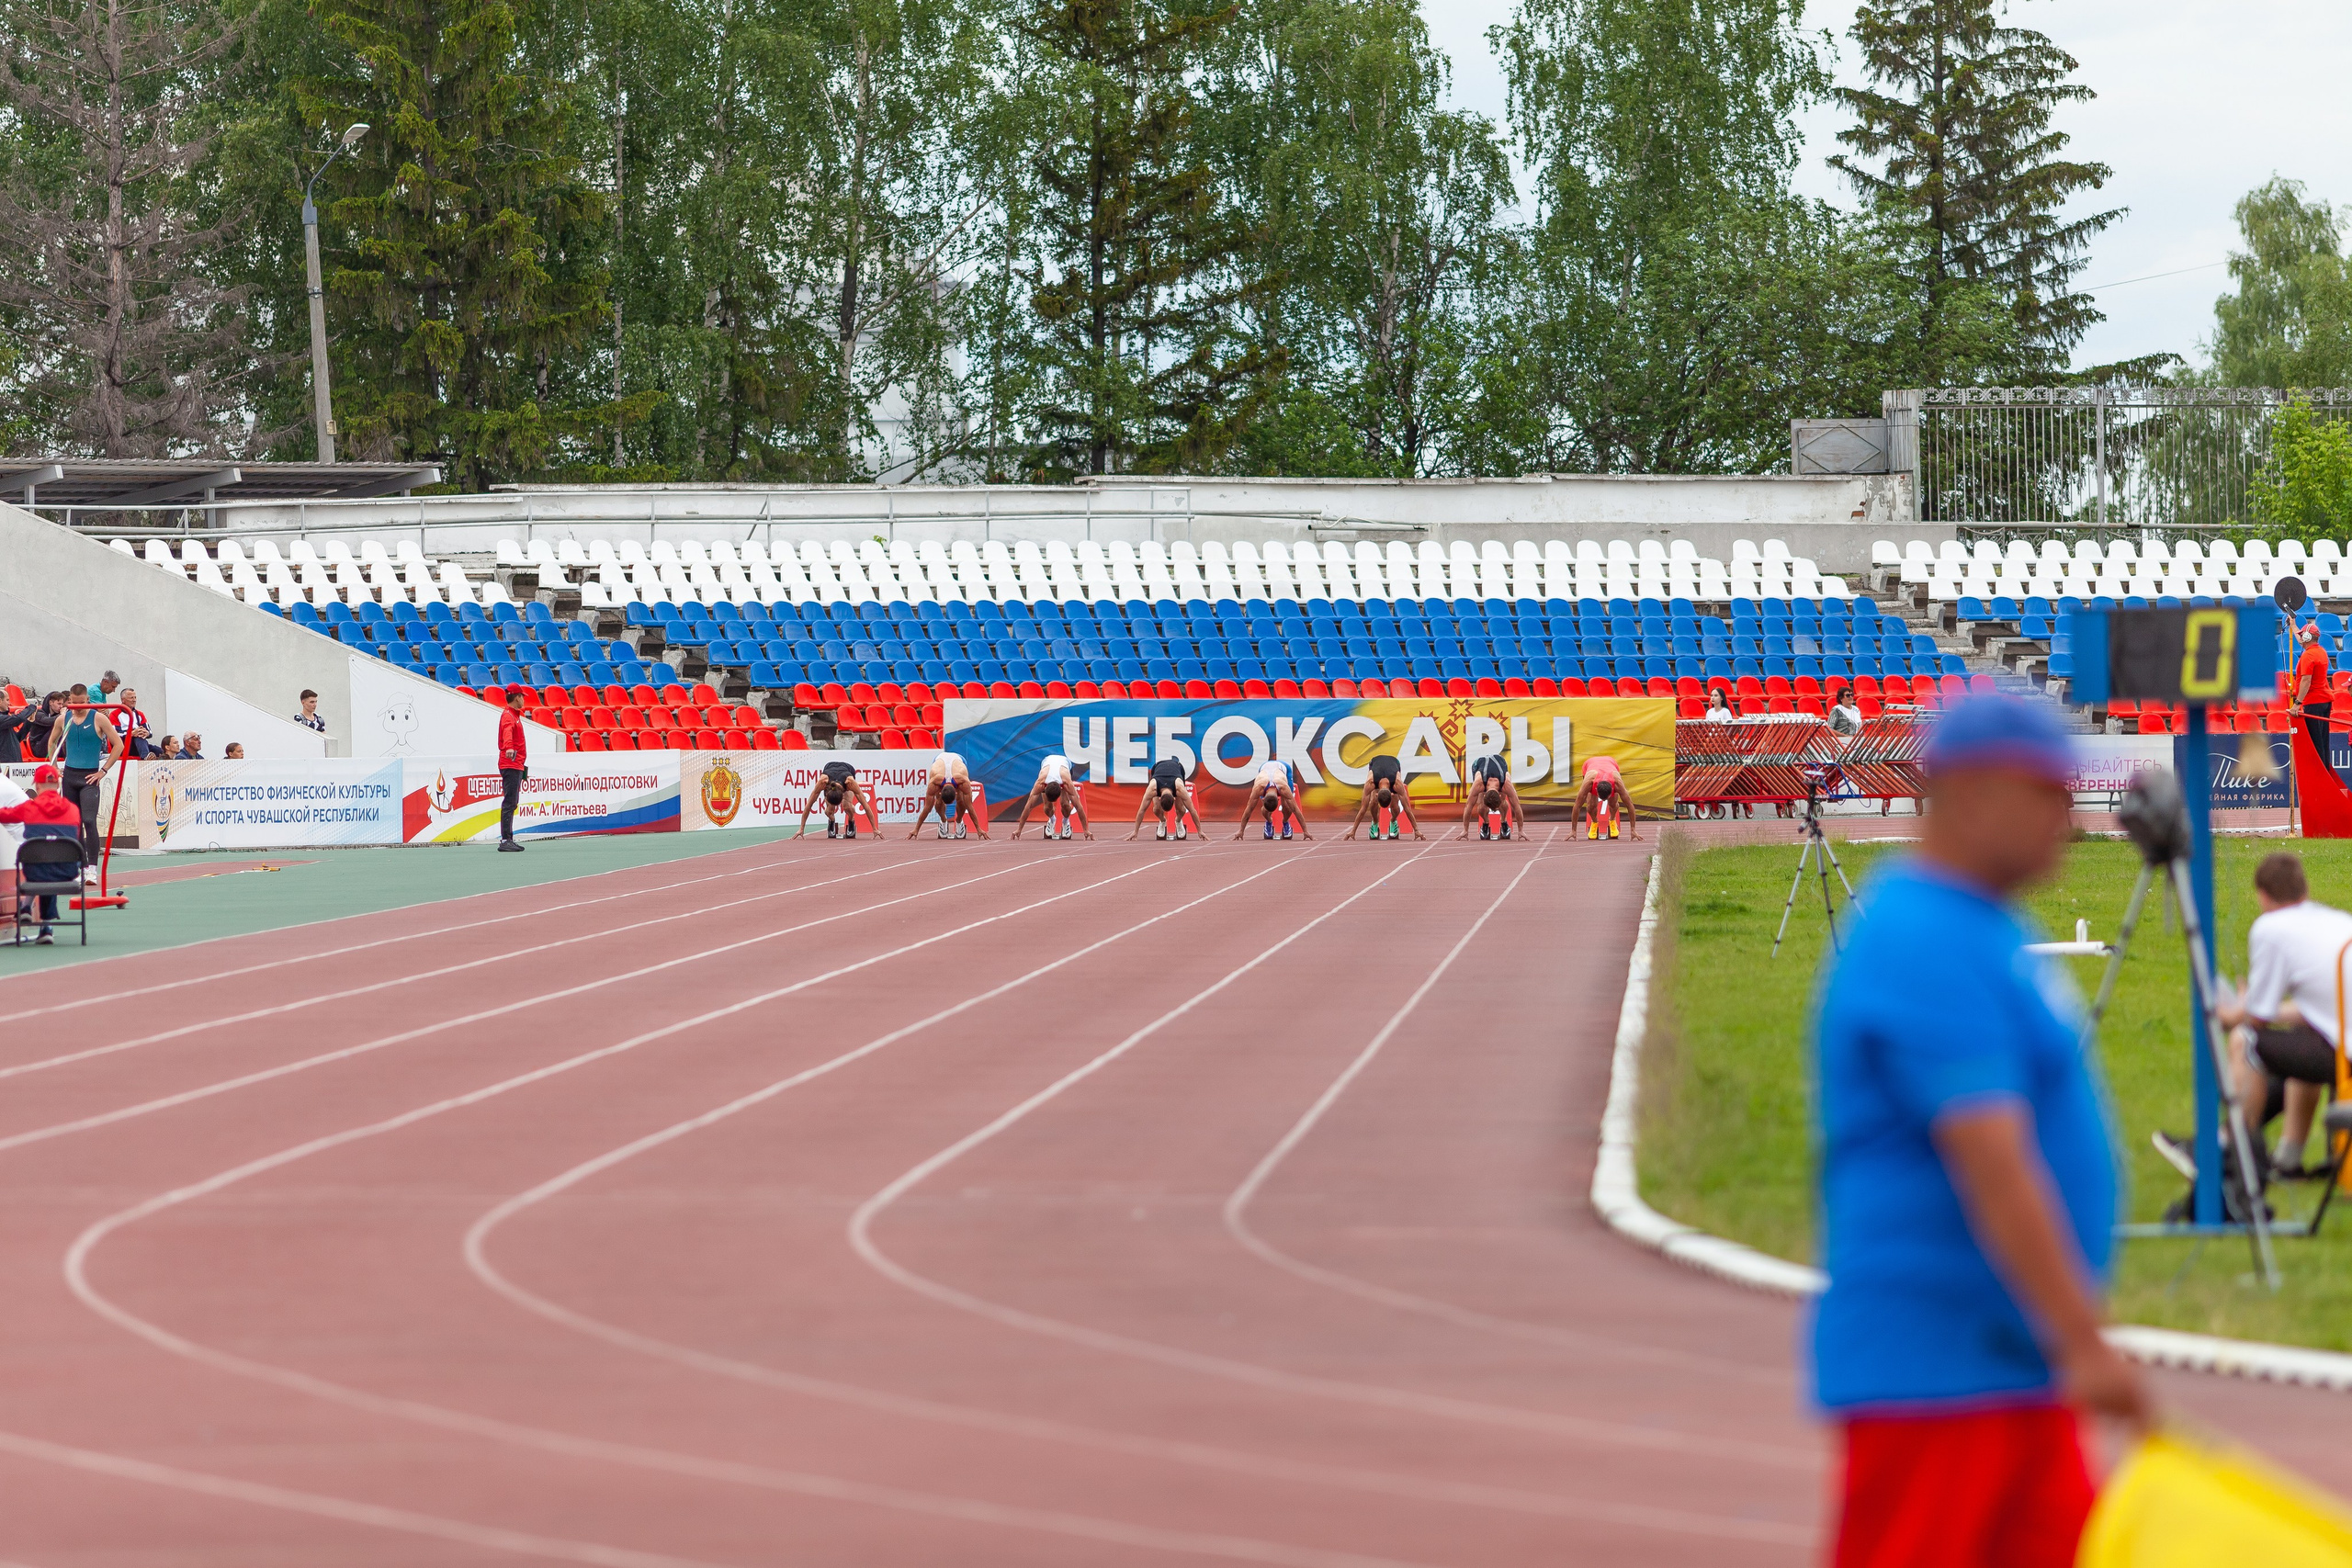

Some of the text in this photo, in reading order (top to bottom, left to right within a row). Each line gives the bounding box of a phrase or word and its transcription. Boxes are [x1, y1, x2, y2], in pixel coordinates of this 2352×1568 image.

[2181, 609, 2235, 698] 0
[1063, 715, 1570, 785] ЧЕБОКСАРЫ
[2078, 756, 2163, 773] ЫБАЙТЕСЬ
[518, 773, 581, 793] ОРТИВНОЙ
[583, 775, 658, 792] ПОДГОТОВКИ
[784, 769, 927, 788] АДМСТРАЦИЯ
[185, 782, 390, 801] МИНИСТЕРСТВО ФИЗИЧЕСКОЙ КУЛЬТУРЫ
[2209, 793, 2285, 801] ЕЙНАЯ ФАБРИКА
[196, 806, 379, 825] И СПОРТА ЧУВАШСКОЙ РЕСПУБЛИКИ
[519, 802, 607, 817] им. А. Игнатьева
